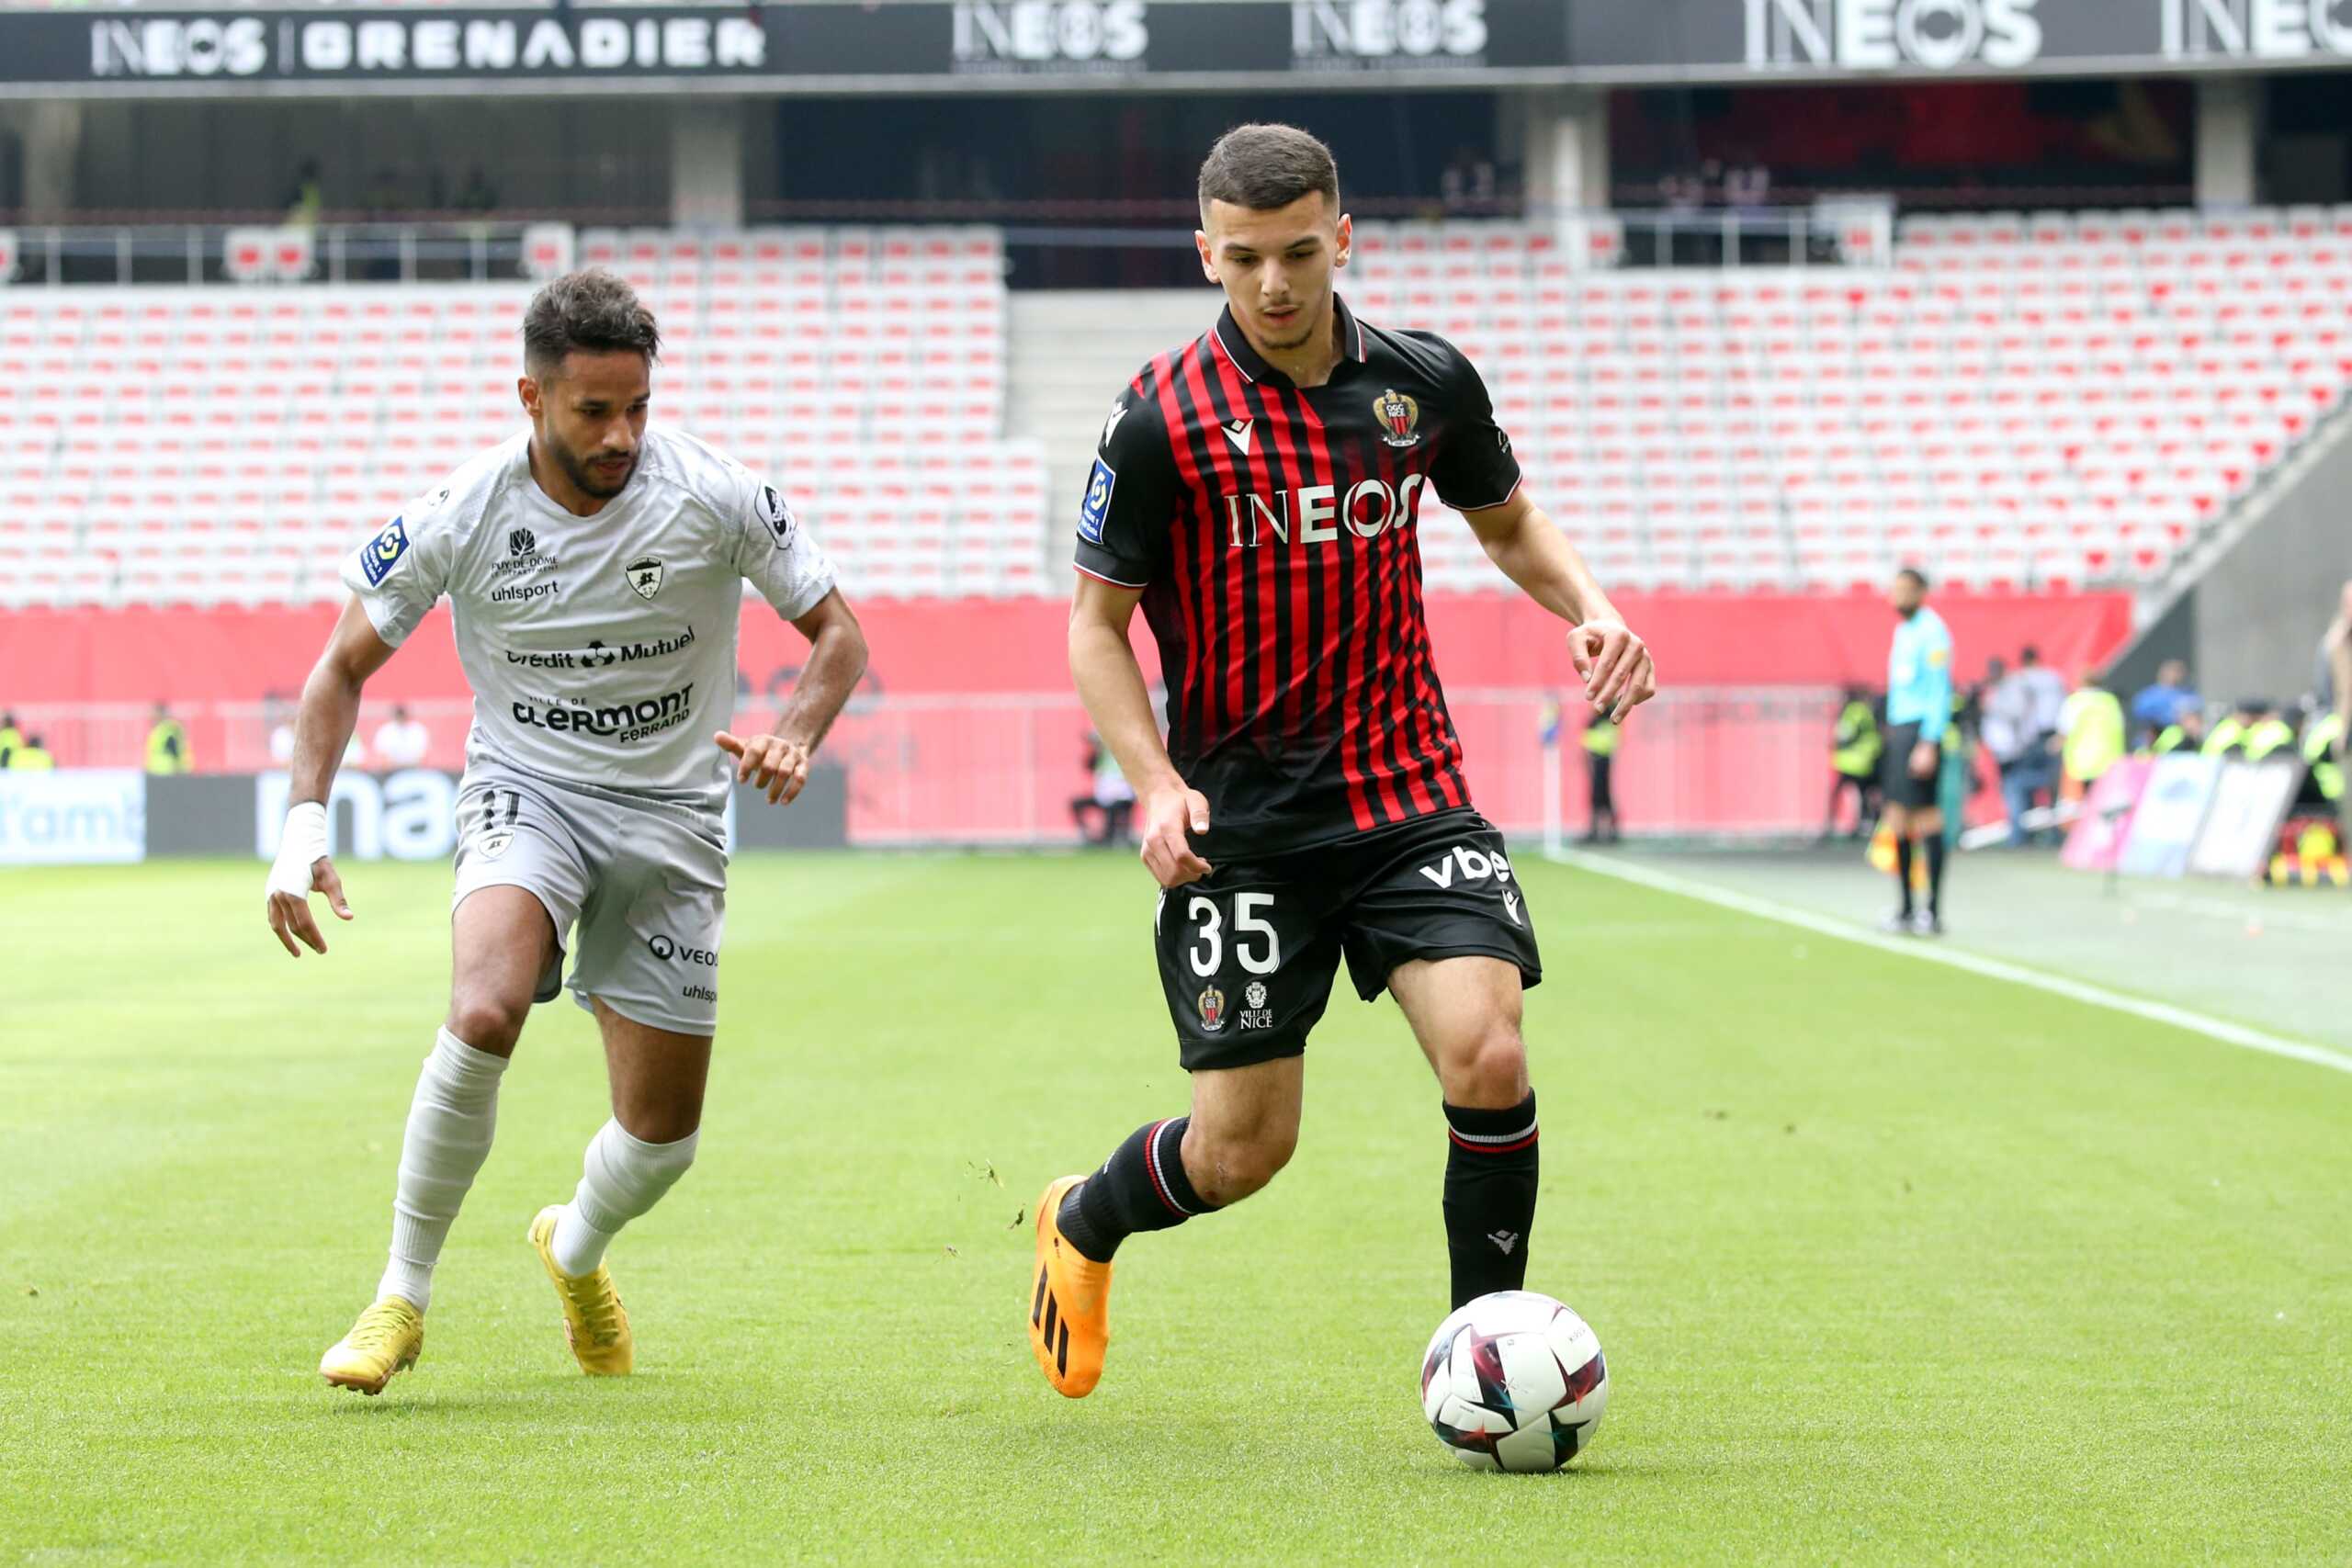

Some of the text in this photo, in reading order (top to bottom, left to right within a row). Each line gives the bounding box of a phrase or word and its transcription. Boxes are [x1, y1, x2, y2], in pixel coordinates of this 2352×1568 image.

[91, 17, 765, 75] INEOS GRENADIER
[953, 1, 1148, 61] INEOS
[1290, 0, 1487, 57] INEOS
[1744, 0, 2042, 72] INEOS
[1224, 473, 1423, 547] INEOS
[492, 580, 559, 602] uhlsport
[620, 625, 695, 662] Mutuel
[571, 697, 588, 706] DE
[1419, 846, 1514, 889] vbe
[1188, 892, 1280, 977] 35
[1240, 1016, 1272, 1030] NICE
